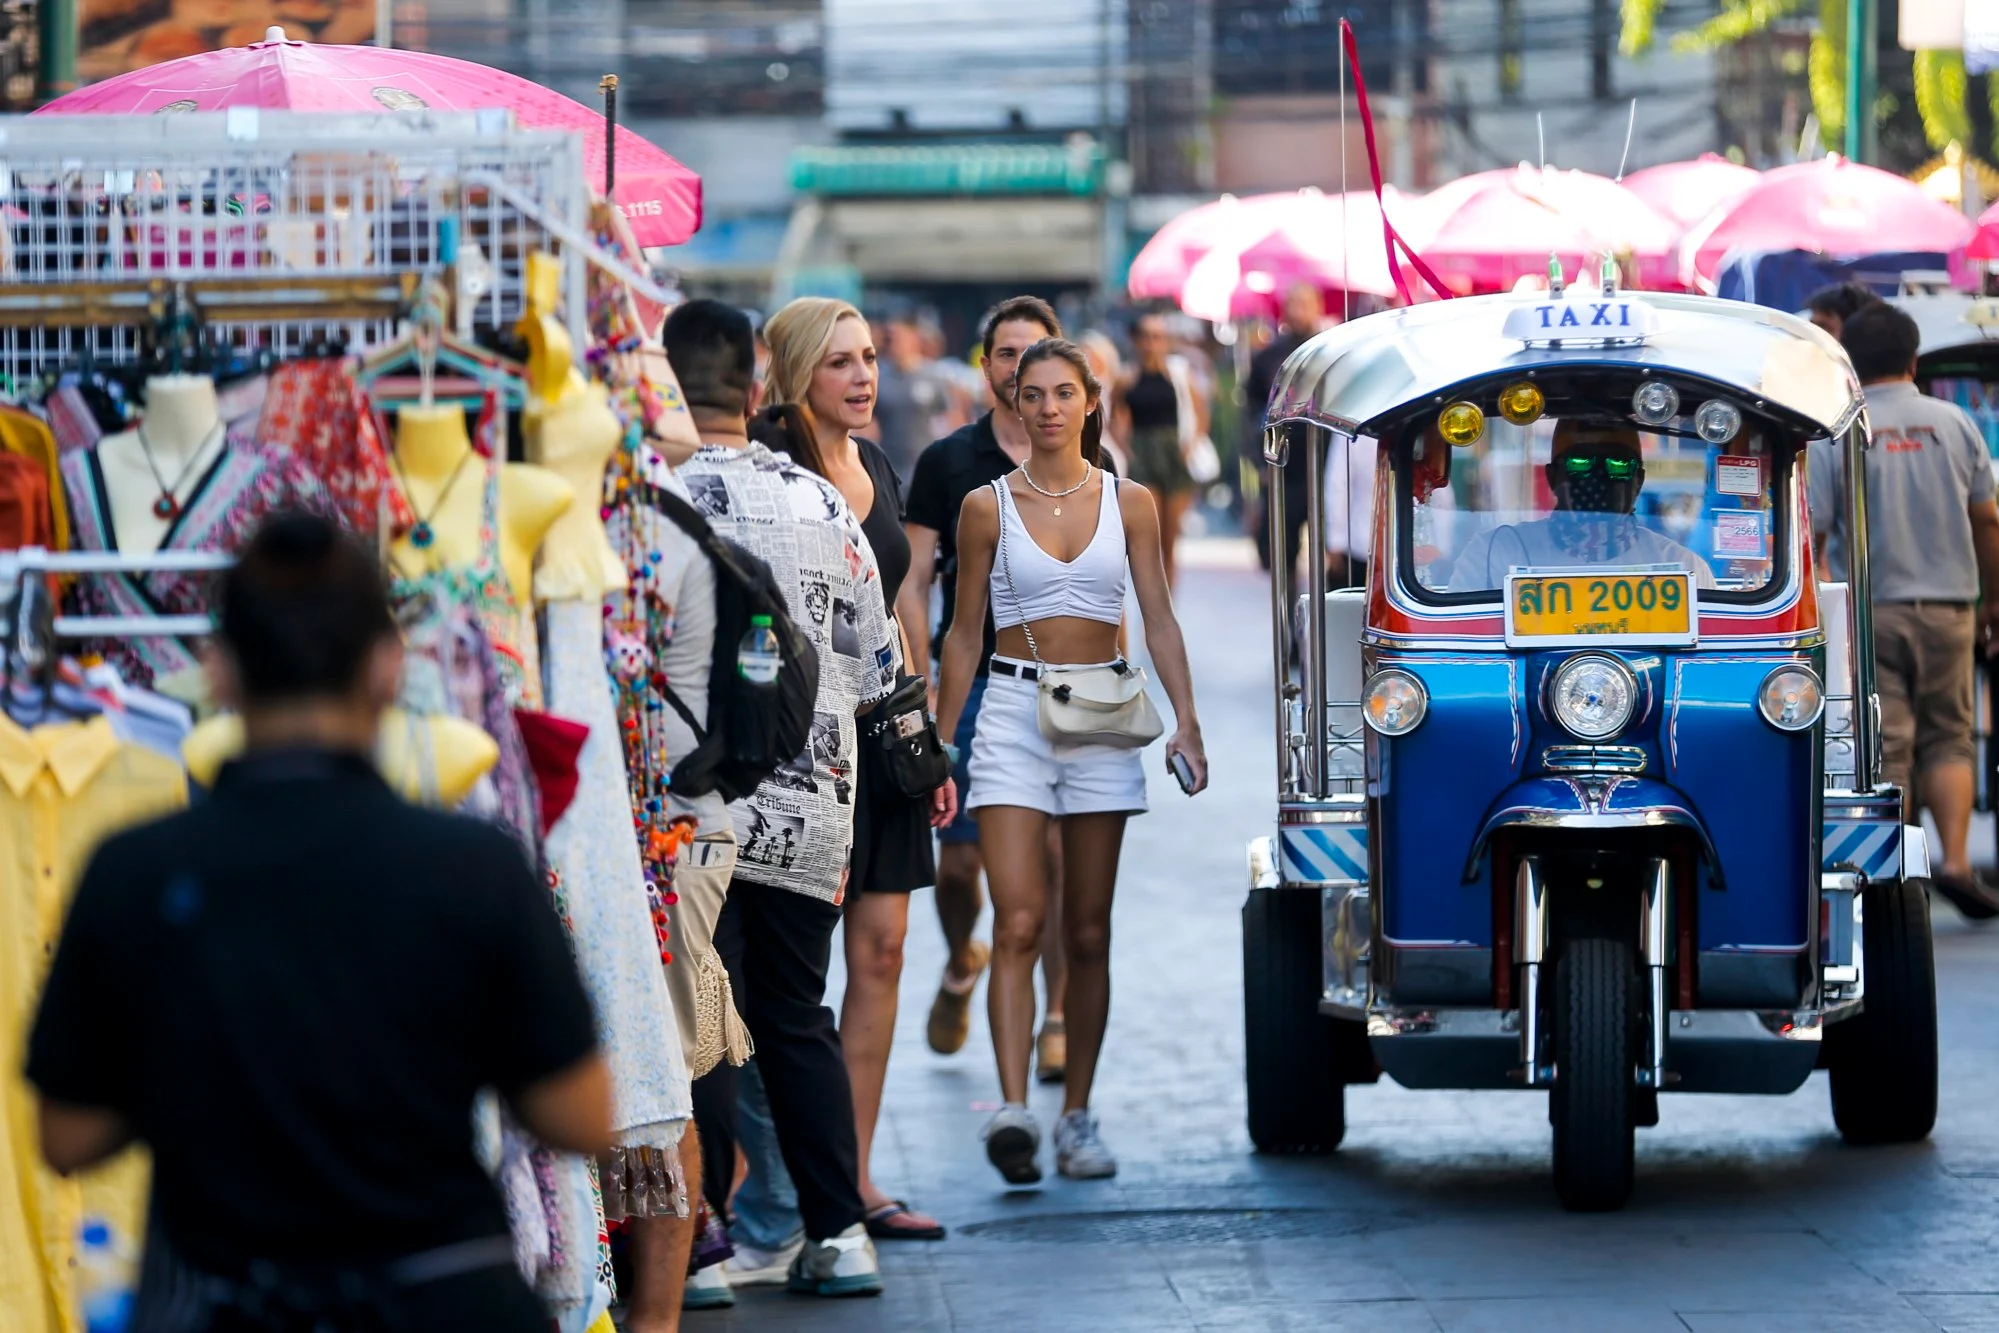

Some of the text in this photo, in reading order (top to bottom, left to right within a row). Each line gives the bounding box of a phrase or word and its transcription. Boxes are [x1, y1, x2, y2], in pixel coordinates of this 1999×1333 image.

[1535, 303, 1630, 328] TAXI
[1739, 459, 1757, 467] LPG
[1735, 526, 1759, 536] 2566
[1519, 579, 1681, 616] สก 2009
[756, 795, 801, 815] Tribune
